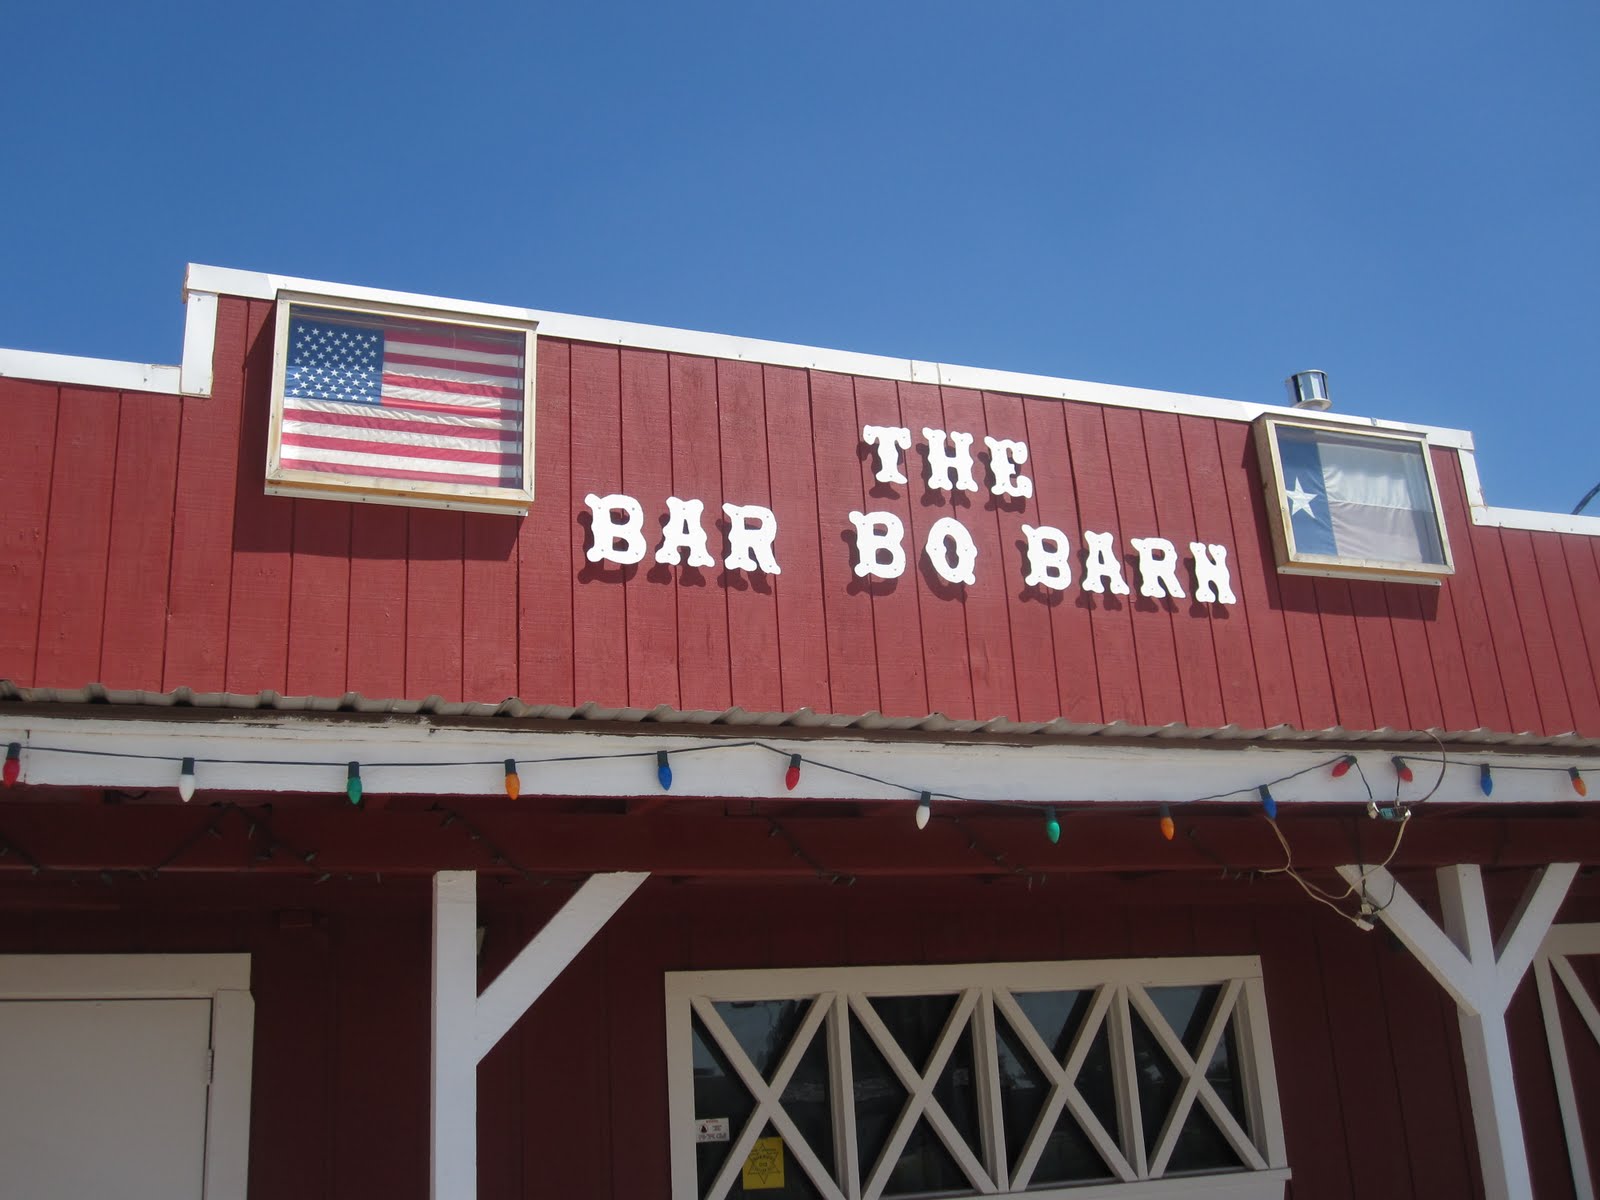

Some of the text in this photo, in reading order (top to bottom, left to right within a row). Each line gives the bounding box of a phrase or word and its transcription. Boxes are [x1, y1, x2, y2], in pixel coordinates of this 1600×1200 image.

[862, 424, 1033, 499] THE
[584, 493, 1237, 605] BAR BQ BARN
